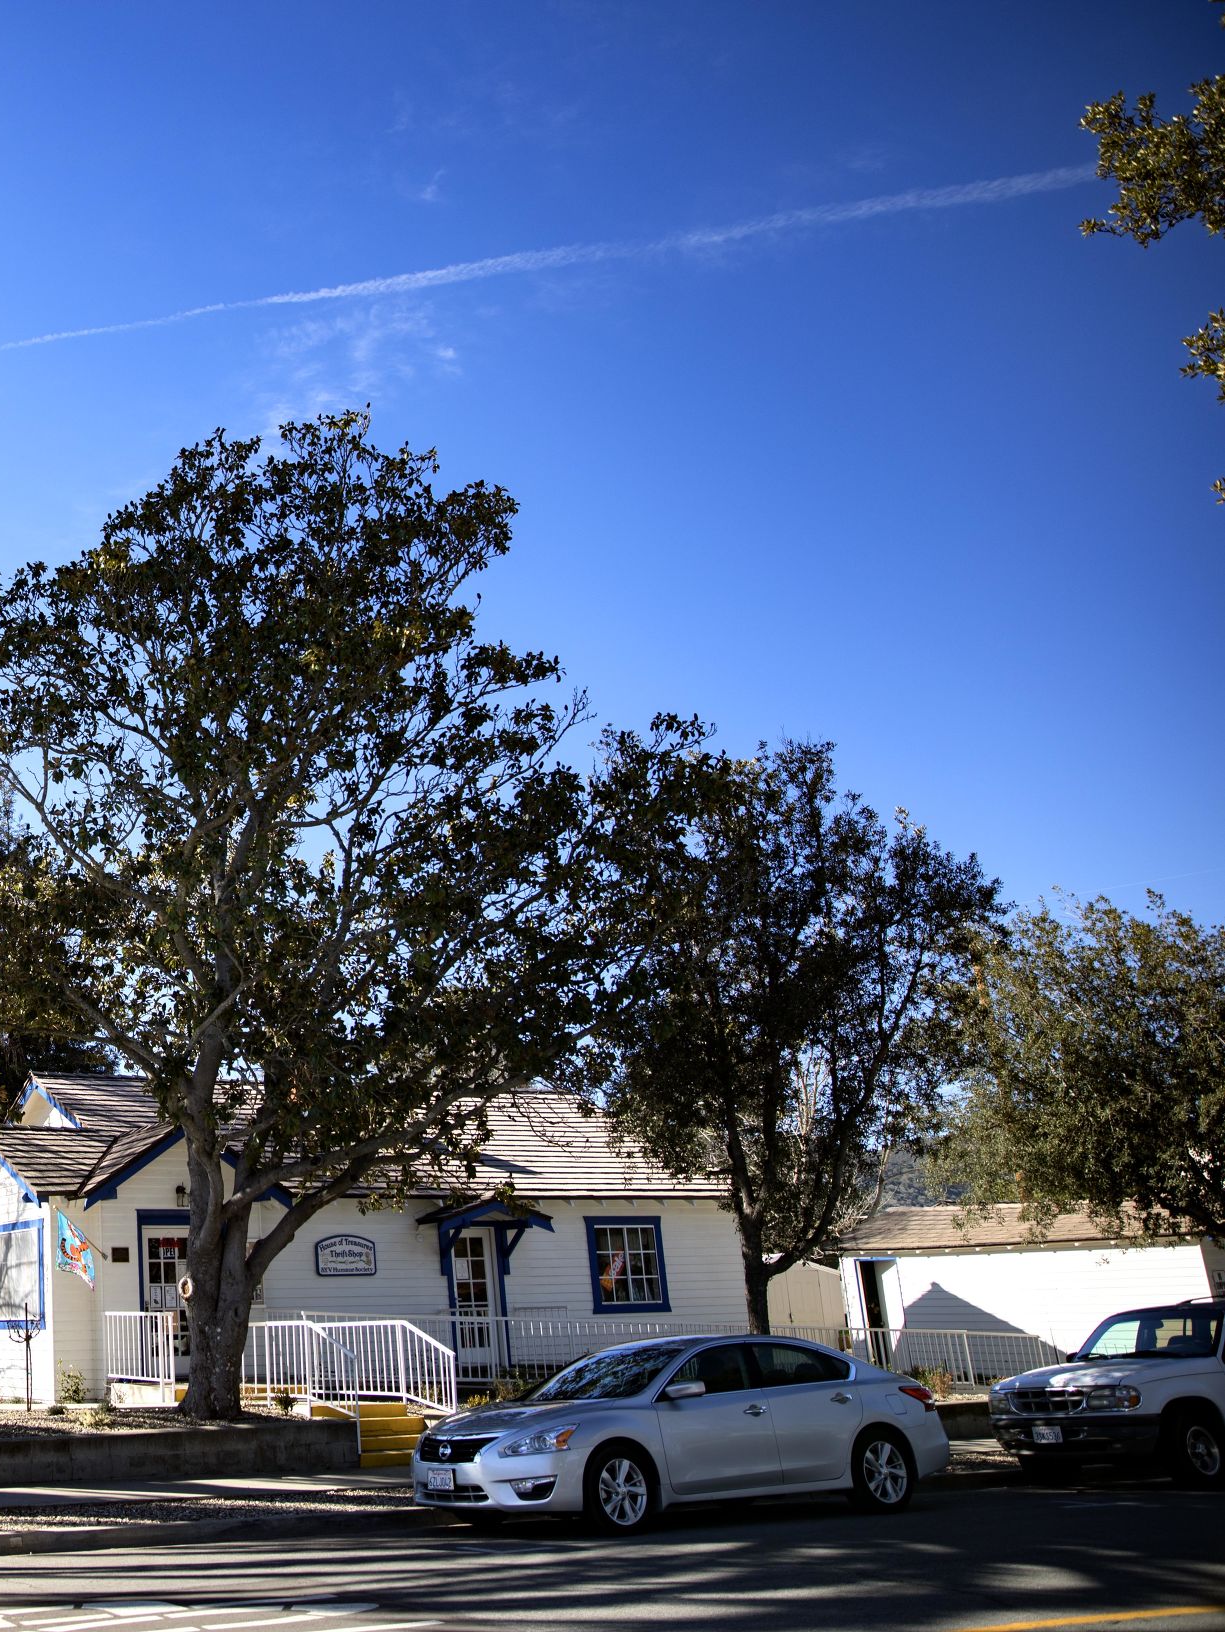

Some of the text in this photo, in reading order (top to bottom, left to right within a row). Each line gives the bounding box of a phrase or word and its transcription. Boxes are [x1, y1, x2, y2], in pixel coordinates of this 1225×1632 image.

[318, 1241, 337, 1252] House
[344, 1238, 373, 1251] Treasures
[330, 1250, 364, 1258] Thrift Shop
